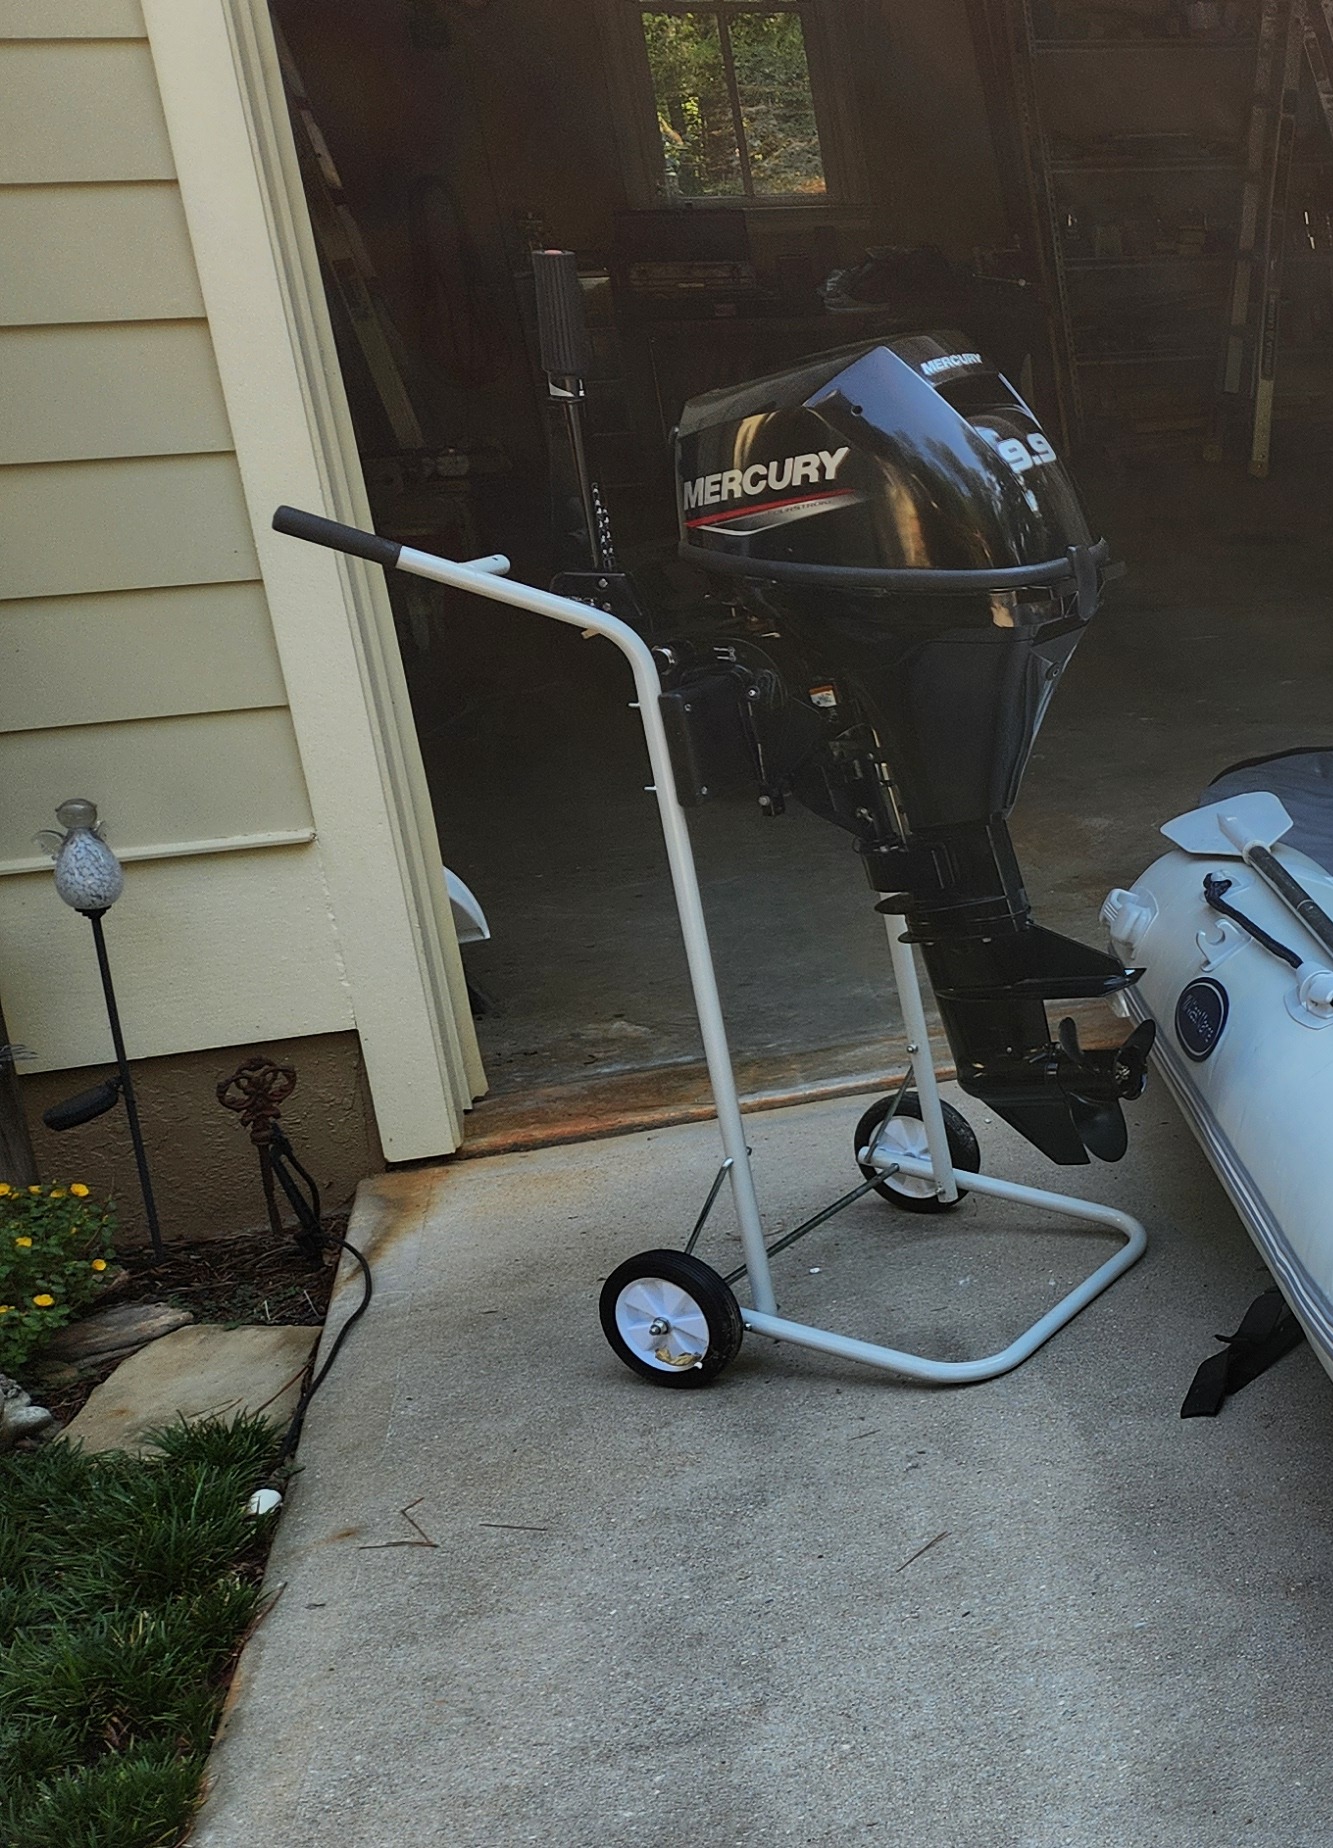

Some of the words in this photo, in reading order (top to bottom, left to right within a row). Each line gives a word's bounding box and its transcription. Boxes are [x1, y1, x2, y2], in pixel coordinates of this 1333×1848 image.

[920, 353, 983, 376] MERCURY
[998, 432, 1057, 474] 9.9
[683, 446, 850, 511] MERCURY
